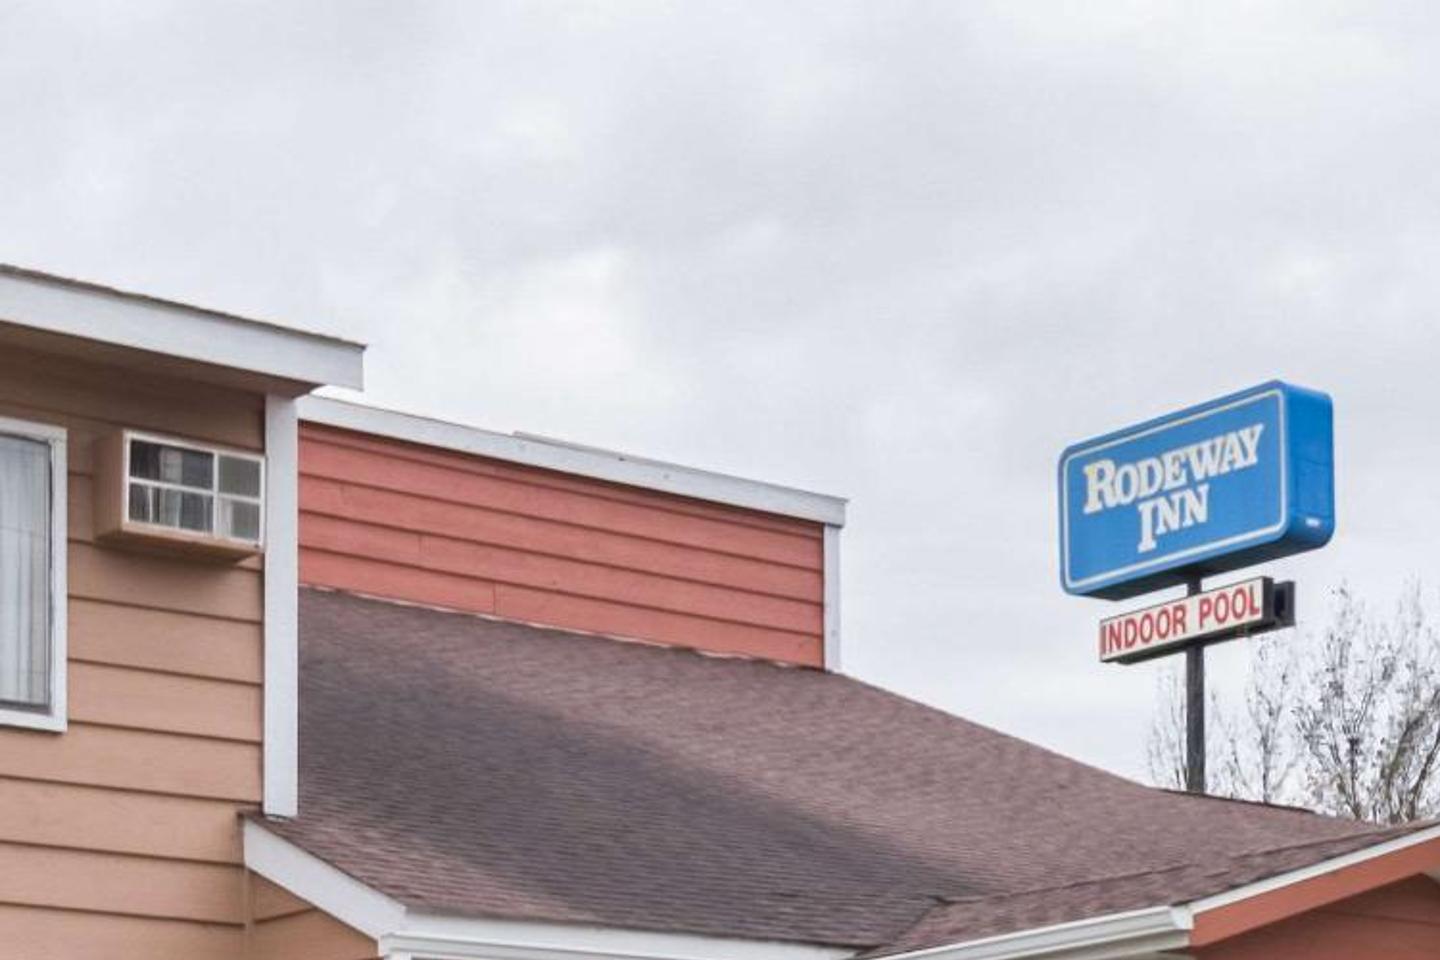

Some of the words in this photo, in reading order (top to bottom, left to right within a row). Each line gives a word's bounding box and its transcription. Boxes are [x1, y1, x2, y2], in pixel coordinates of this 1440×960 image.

[1082, 423, 1264, 515] RODEWAY
[1137, 483, 1210, 553] INN
[1101, 603, 1188, 655] INDOOR
[1198, 585, 1261, 631] POOL
